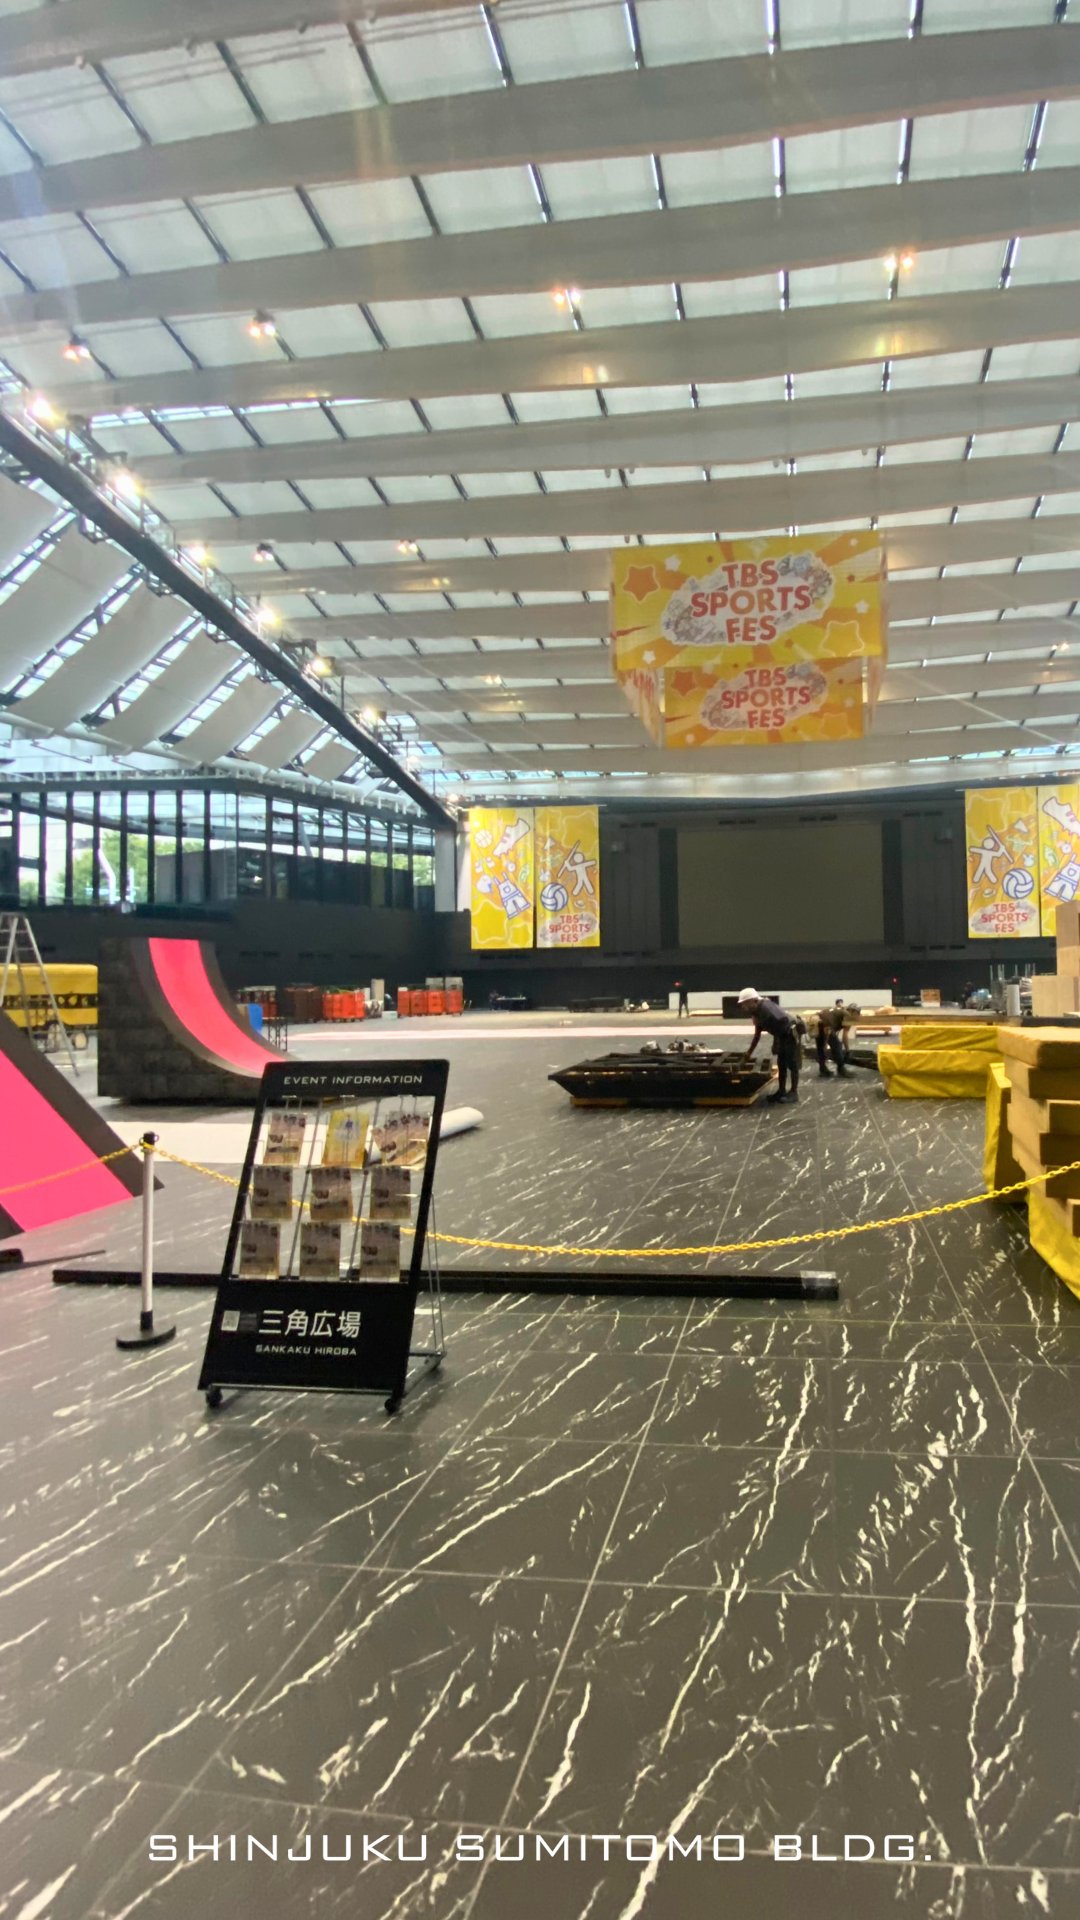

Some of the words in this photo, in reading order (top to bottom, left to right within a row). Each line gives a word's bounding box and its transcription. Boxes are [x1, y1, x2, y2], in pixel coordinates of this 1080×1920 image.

[722, 560, 778, 588] TBS
[690, 585, 812, 618] SPORTS
[726, 615, 777, 644] FES
[745, 667, 787, 687] TBS
[720, 686, 812, 710] SPORTS
[747, 708, 786, 729] FES
[993, 903, 1016, 912] TBS
[560, 915, 579, 924] TBS
[981, 913, 1028, 923] SPORTS
[549, 924, 591, 933] SPORTS
[995, 923, 1015, 932] FES
[561, 934, 578, 942] FES
[283, 1076, 328, 1085] EVENT
[332, 1074, 424, 1085] INFORMATION
[258, 1309, 362, 1338] 三角広場
[255, 1344, 311, 1355] SANKAKU
[314, 1346, 357, 1356] HIROBA
